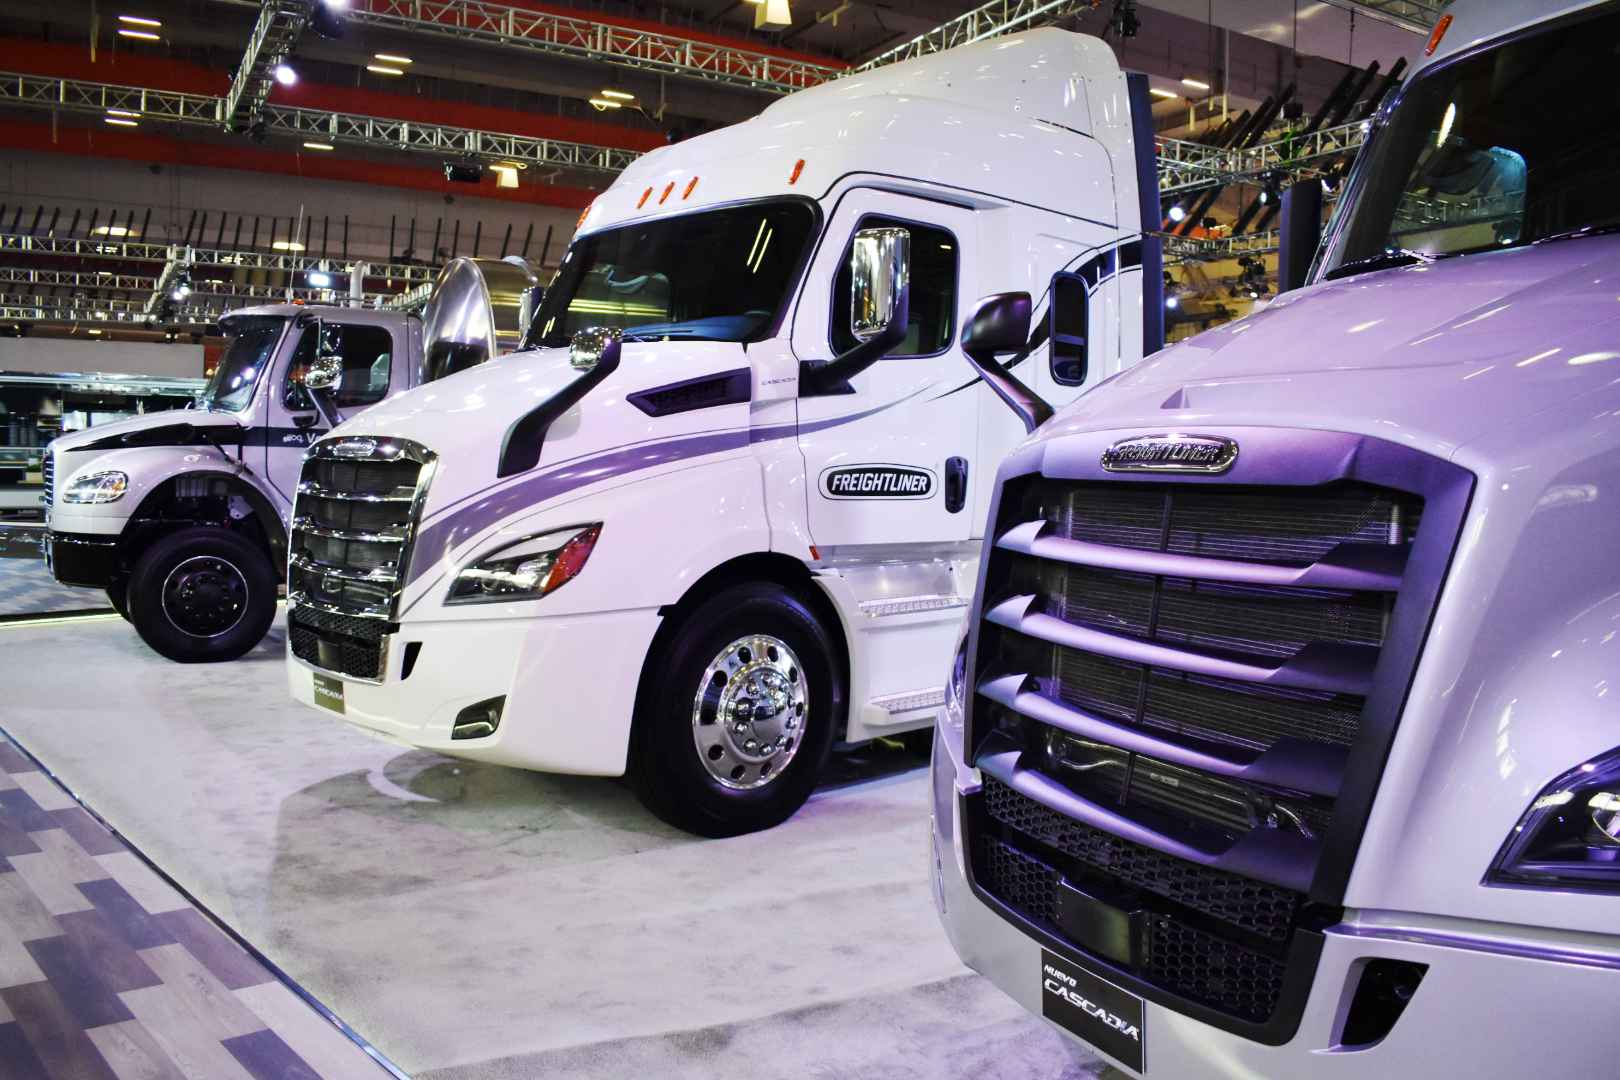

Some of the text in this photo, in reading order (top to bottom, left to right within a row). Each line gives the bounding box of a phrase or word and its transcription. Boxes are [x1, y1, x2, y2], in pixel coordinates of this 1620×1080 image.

[831, 472, 928, 492] FREIGHTLINER
[1043, 964, 1077, 987] NUEVO
[1044, 978, 1140, 1041] CASCADIA
